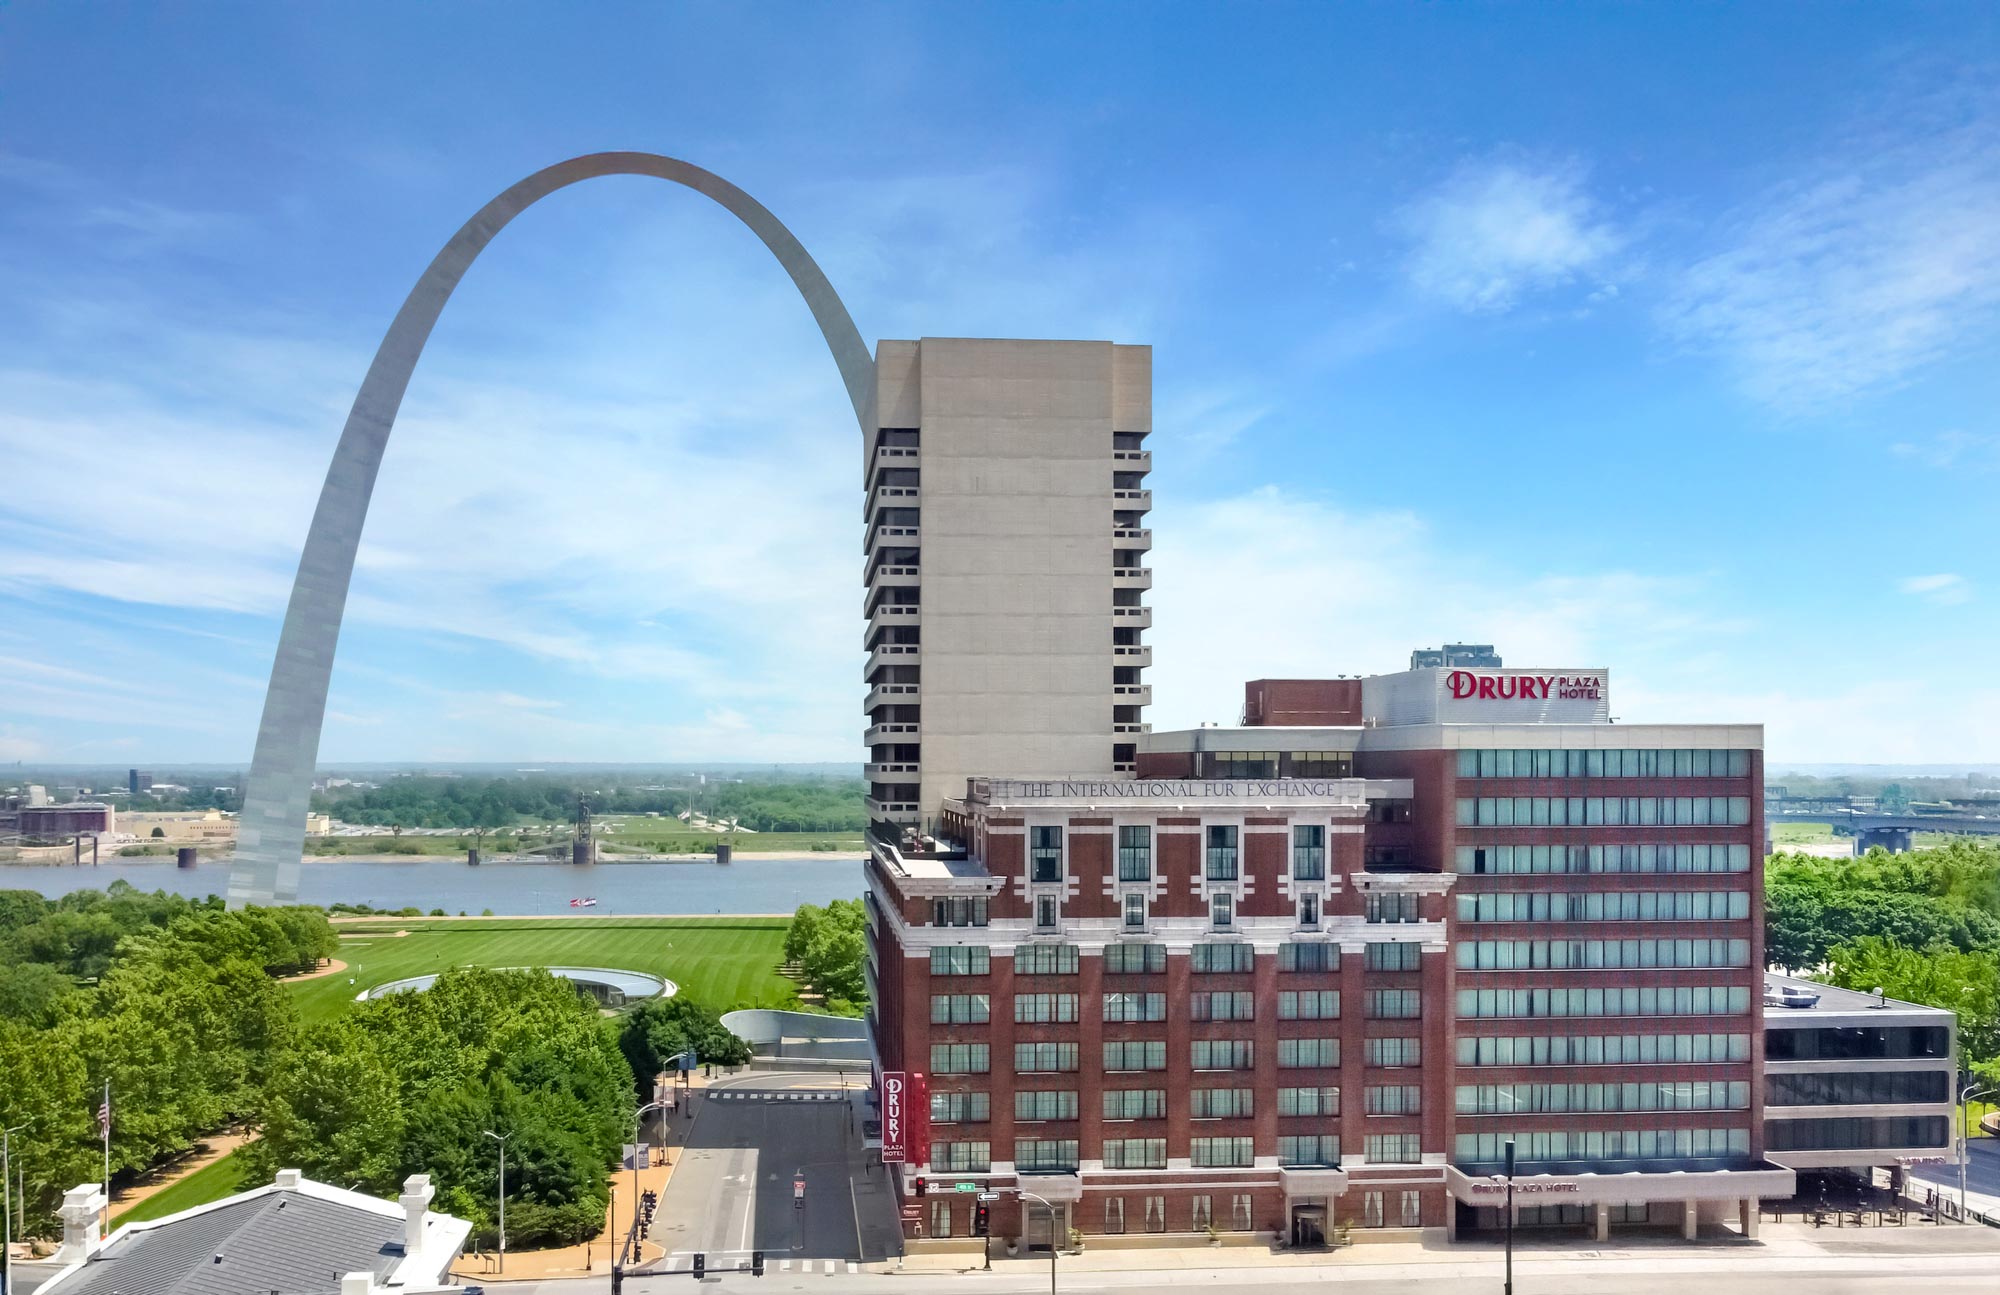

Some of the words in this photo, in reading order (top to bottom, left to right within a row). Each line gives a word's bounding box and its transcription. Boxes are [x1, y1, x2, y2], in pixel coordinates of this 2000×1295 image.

[1446, 671, 1555, 699] DRURY
[1559, 677, 1601, 687] PLAZA
[1559, 689, 1602, 700] HOTEL
[1022, 783, 1053, 797] THE
[1062, 783, 1197, 797] INTERNATIONAL
[1204, 783, 1236, 797] FUR
[1247, 783, 1335, 797] EXCHANGE
[885, 1078, 903, 1143] DRURY
[1472, 1183, 1508, 1194] DRURY
[1546, 1183, 1580, 1193] HOTEL
